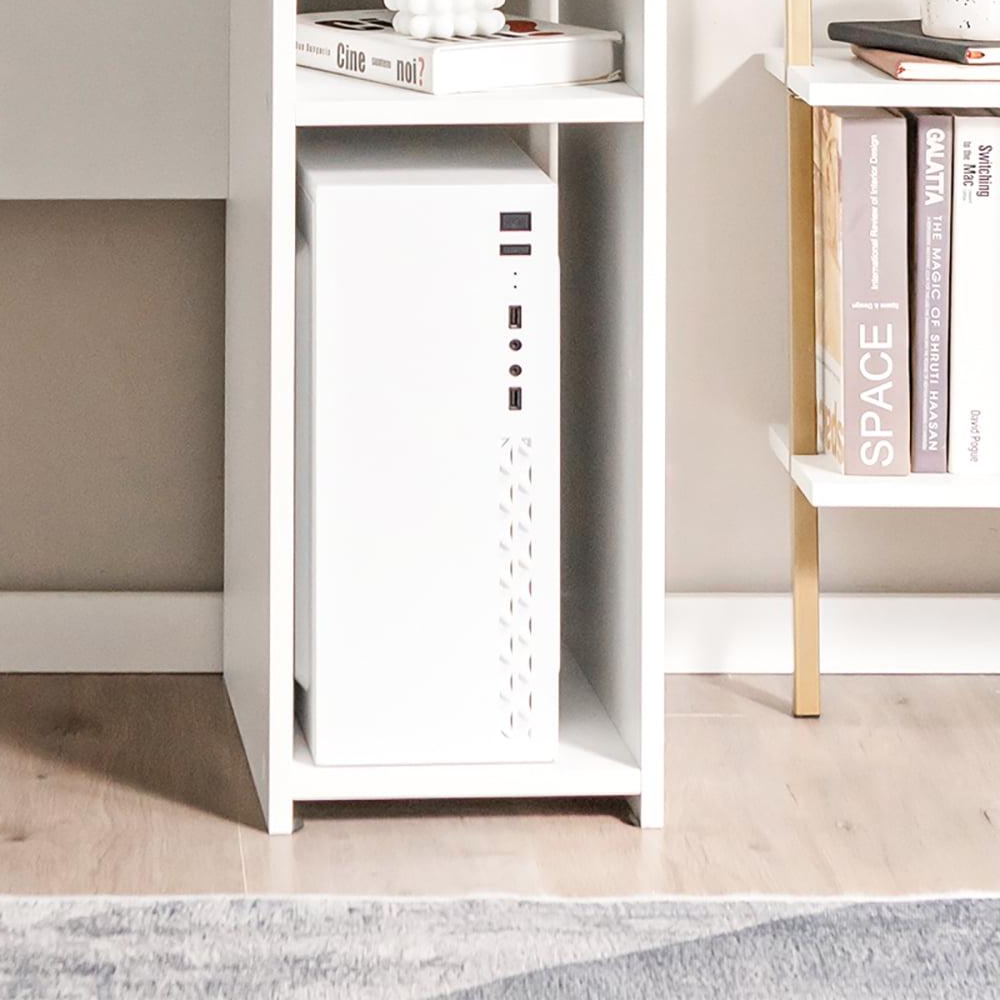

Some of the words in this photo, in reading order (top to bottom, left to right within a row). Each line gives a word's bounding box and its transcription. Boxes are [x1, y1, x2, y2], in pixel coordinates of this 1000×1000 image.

[337, 42, 366, 73] Cine
[396, 56, 425, 86] noi?
[869, 134, 880, 164] Design
[963, 150, 972, 161] the
[870, 165, 879, 195] Interior
[924, 128, 946, 206] GALATTA
[963, 164, 977, 187] Mac
[976, 145, 993, 197] Switching
[870, 195, 879, 205] of
[870, 206, 879, 237] Review
[932, 215, 942, 241] THE
[870, 238, 879, 290] International
[931, 247, 942, 300] MAGIC
[930, 306, 941, 327] OF
[929, 334, 940, 384] SHRUTI
[859, 323, 895, 467] SPACE
[928, 391, 939, 451] HAASAN
[970, 409, 981, 434] David
[967, 435, 981, 462] Pogue
